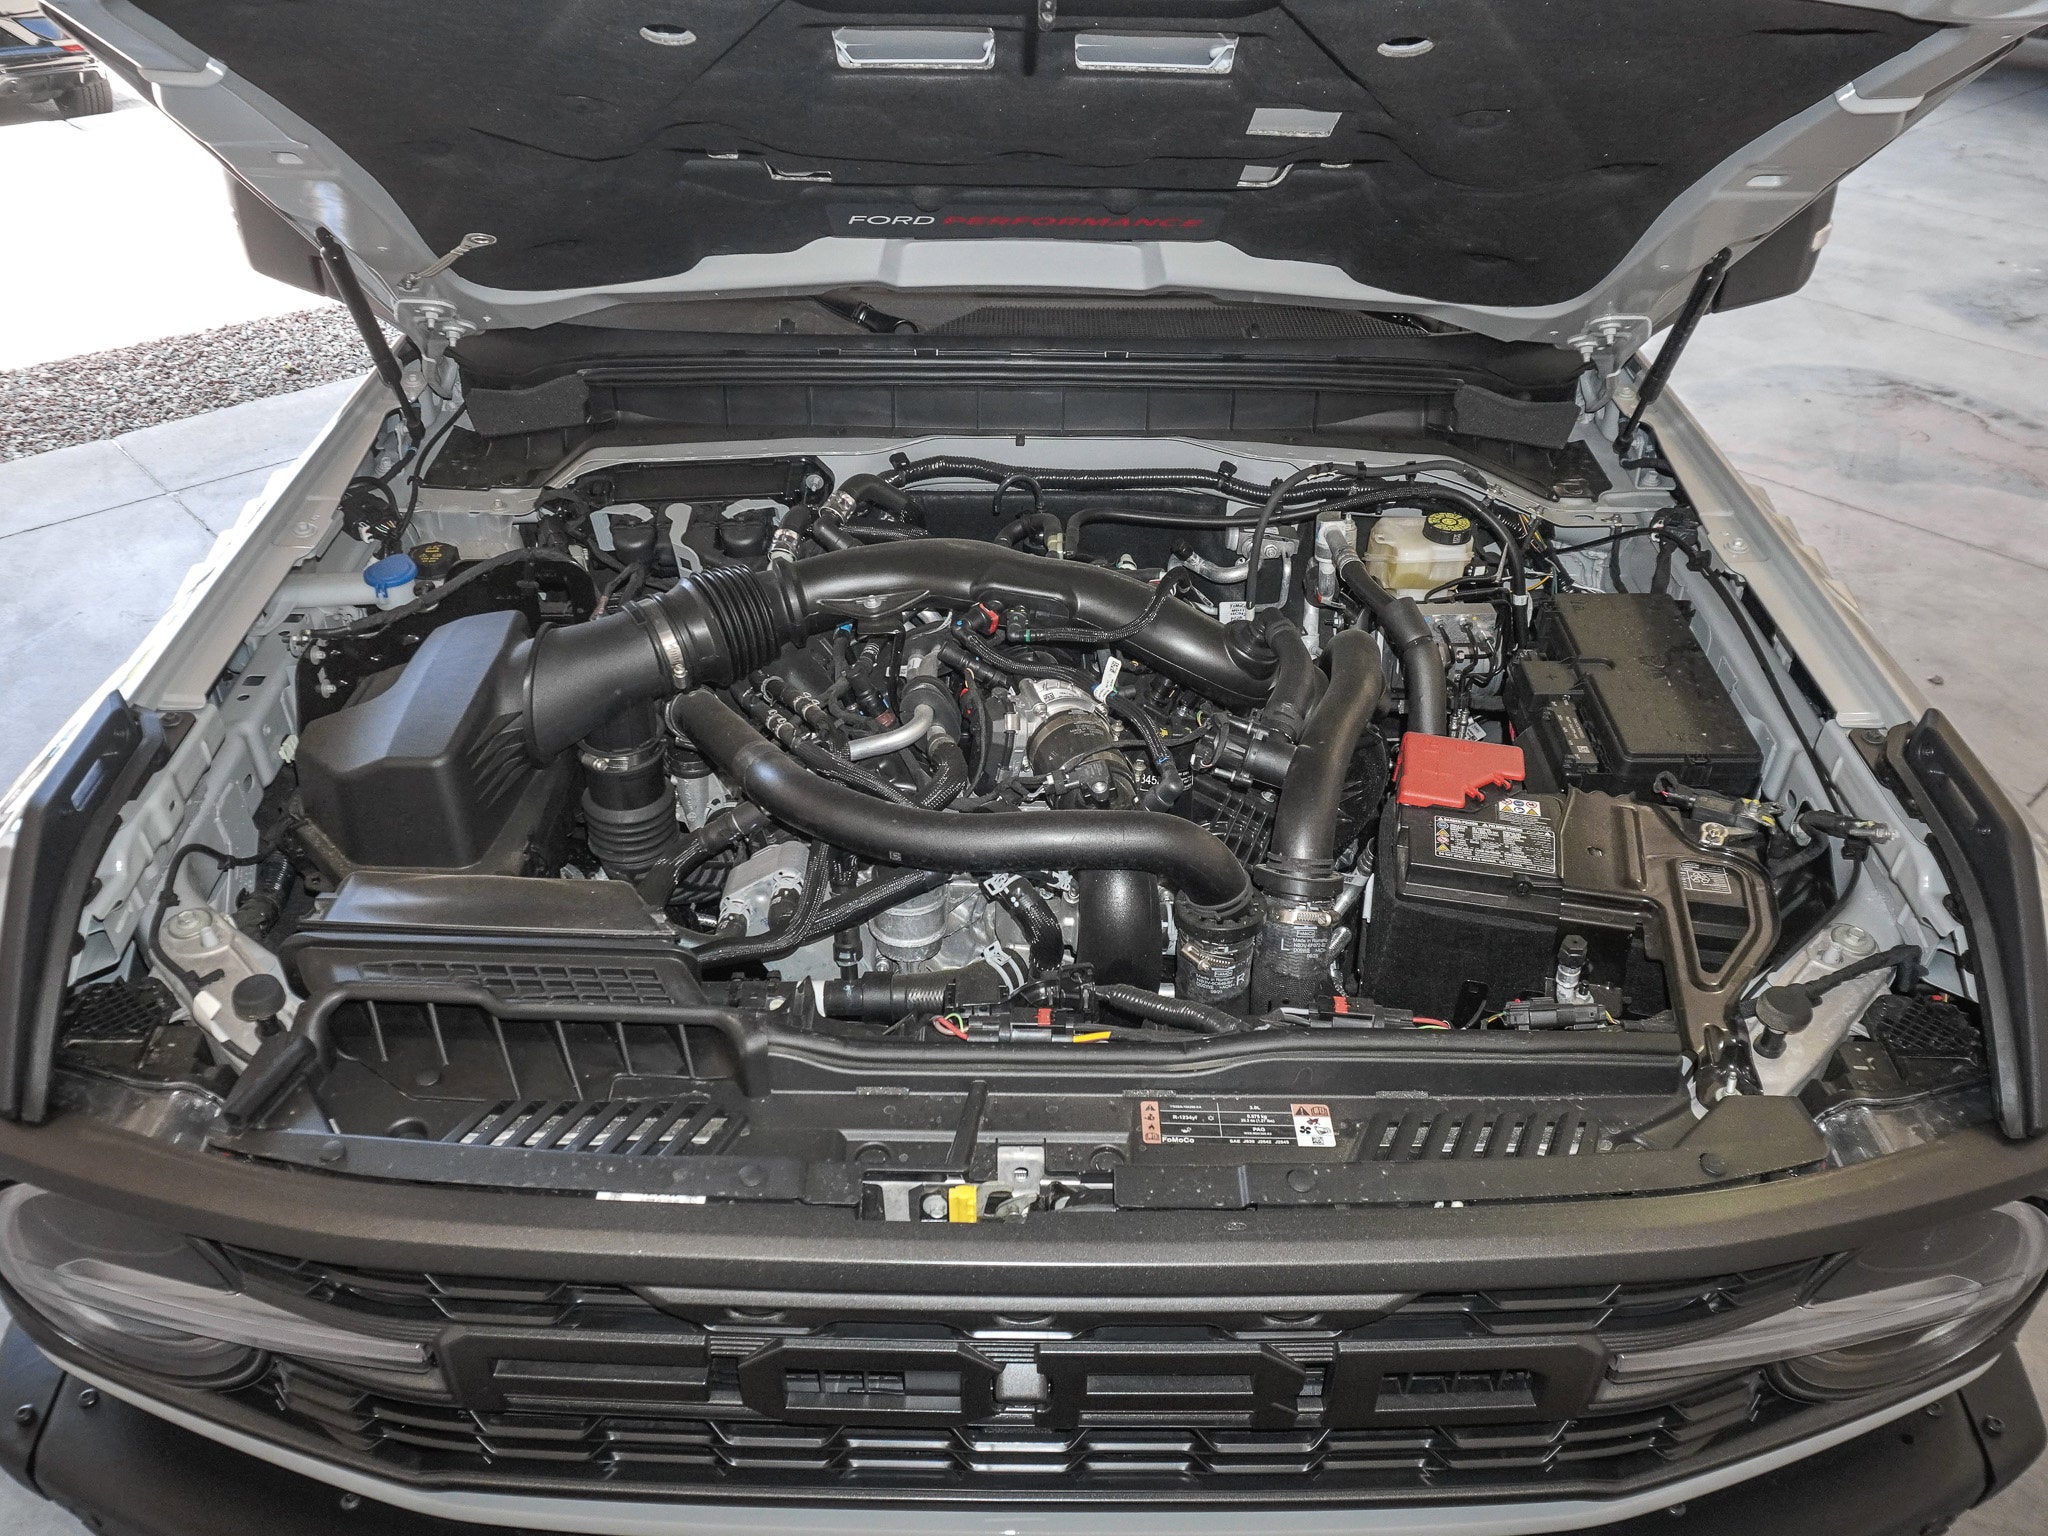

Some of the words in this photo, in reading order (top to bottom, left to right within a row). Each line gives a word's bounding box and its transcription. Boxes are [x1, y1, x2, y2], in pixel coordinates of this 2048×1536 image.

[848, 215, 936, 226] FORD
[943, 215, 1203, 228] PERFORMANCE
[1281, 937, 1290, 951] L
[1236, 972, 1246, 986] R
[1162, 1136, 1195, 1144] FoMoCo
